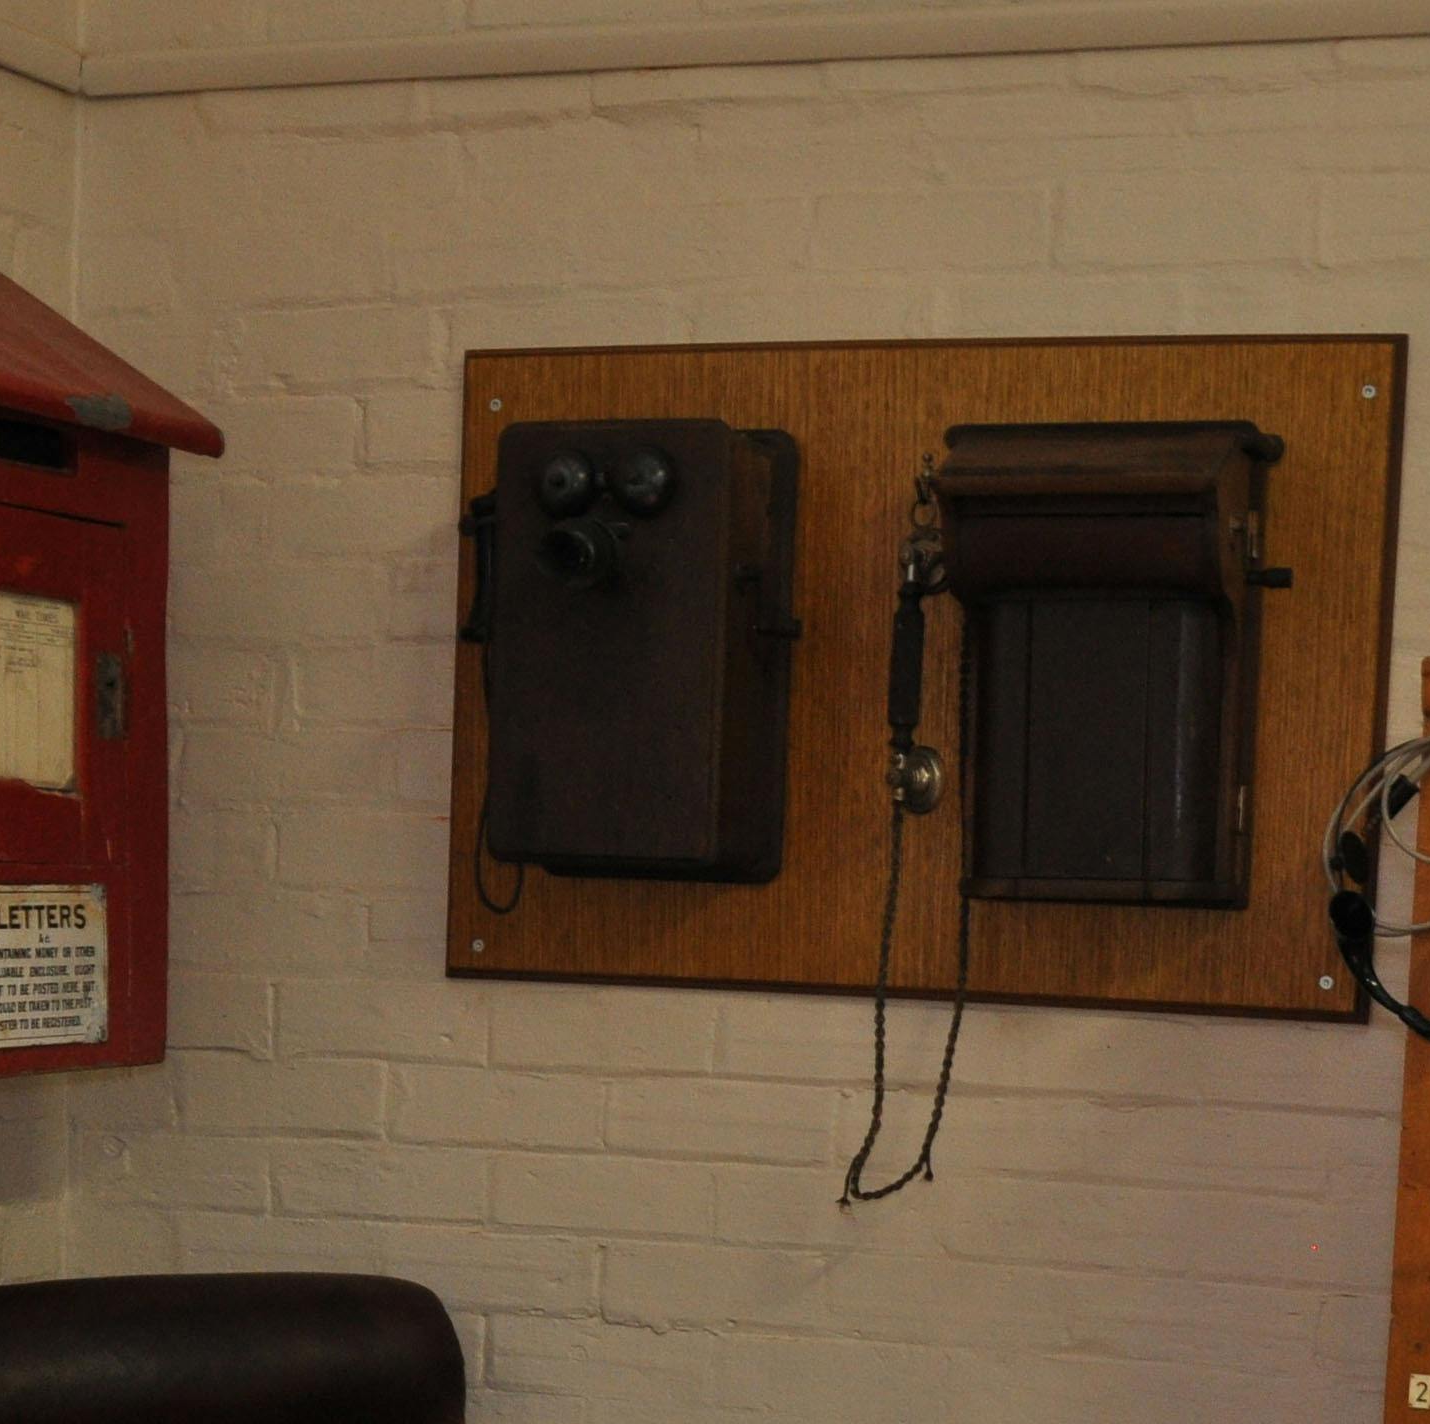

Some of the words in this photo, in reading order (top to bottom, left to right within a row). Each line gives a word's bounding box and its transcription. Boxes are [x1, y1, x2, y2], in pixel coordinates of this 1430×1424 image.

[35, 947, 58, 959] MONEY
[63, 947, 71, 958] OR
[75, 946, 95, 957] OTHER
[75, 964, 95, 976] OUGHT
[7, 984, 16, 995] TO
[20, 984, 30, 995] BE
[33, 983, 59, 994] POSTED
[83, 981, 95, 993] BUT
[18, 1001, 27, 1012] BE
[29, 1000, 50, 1011] TAKEN
[51, 1000, 60, 1010] TO
[62, 999, 74, 1010] THE
[20, 1019, 29, 1029] TO
[31, 1018, 40, 1029] BE
[1416, 1381, 1427, 1402] 2
